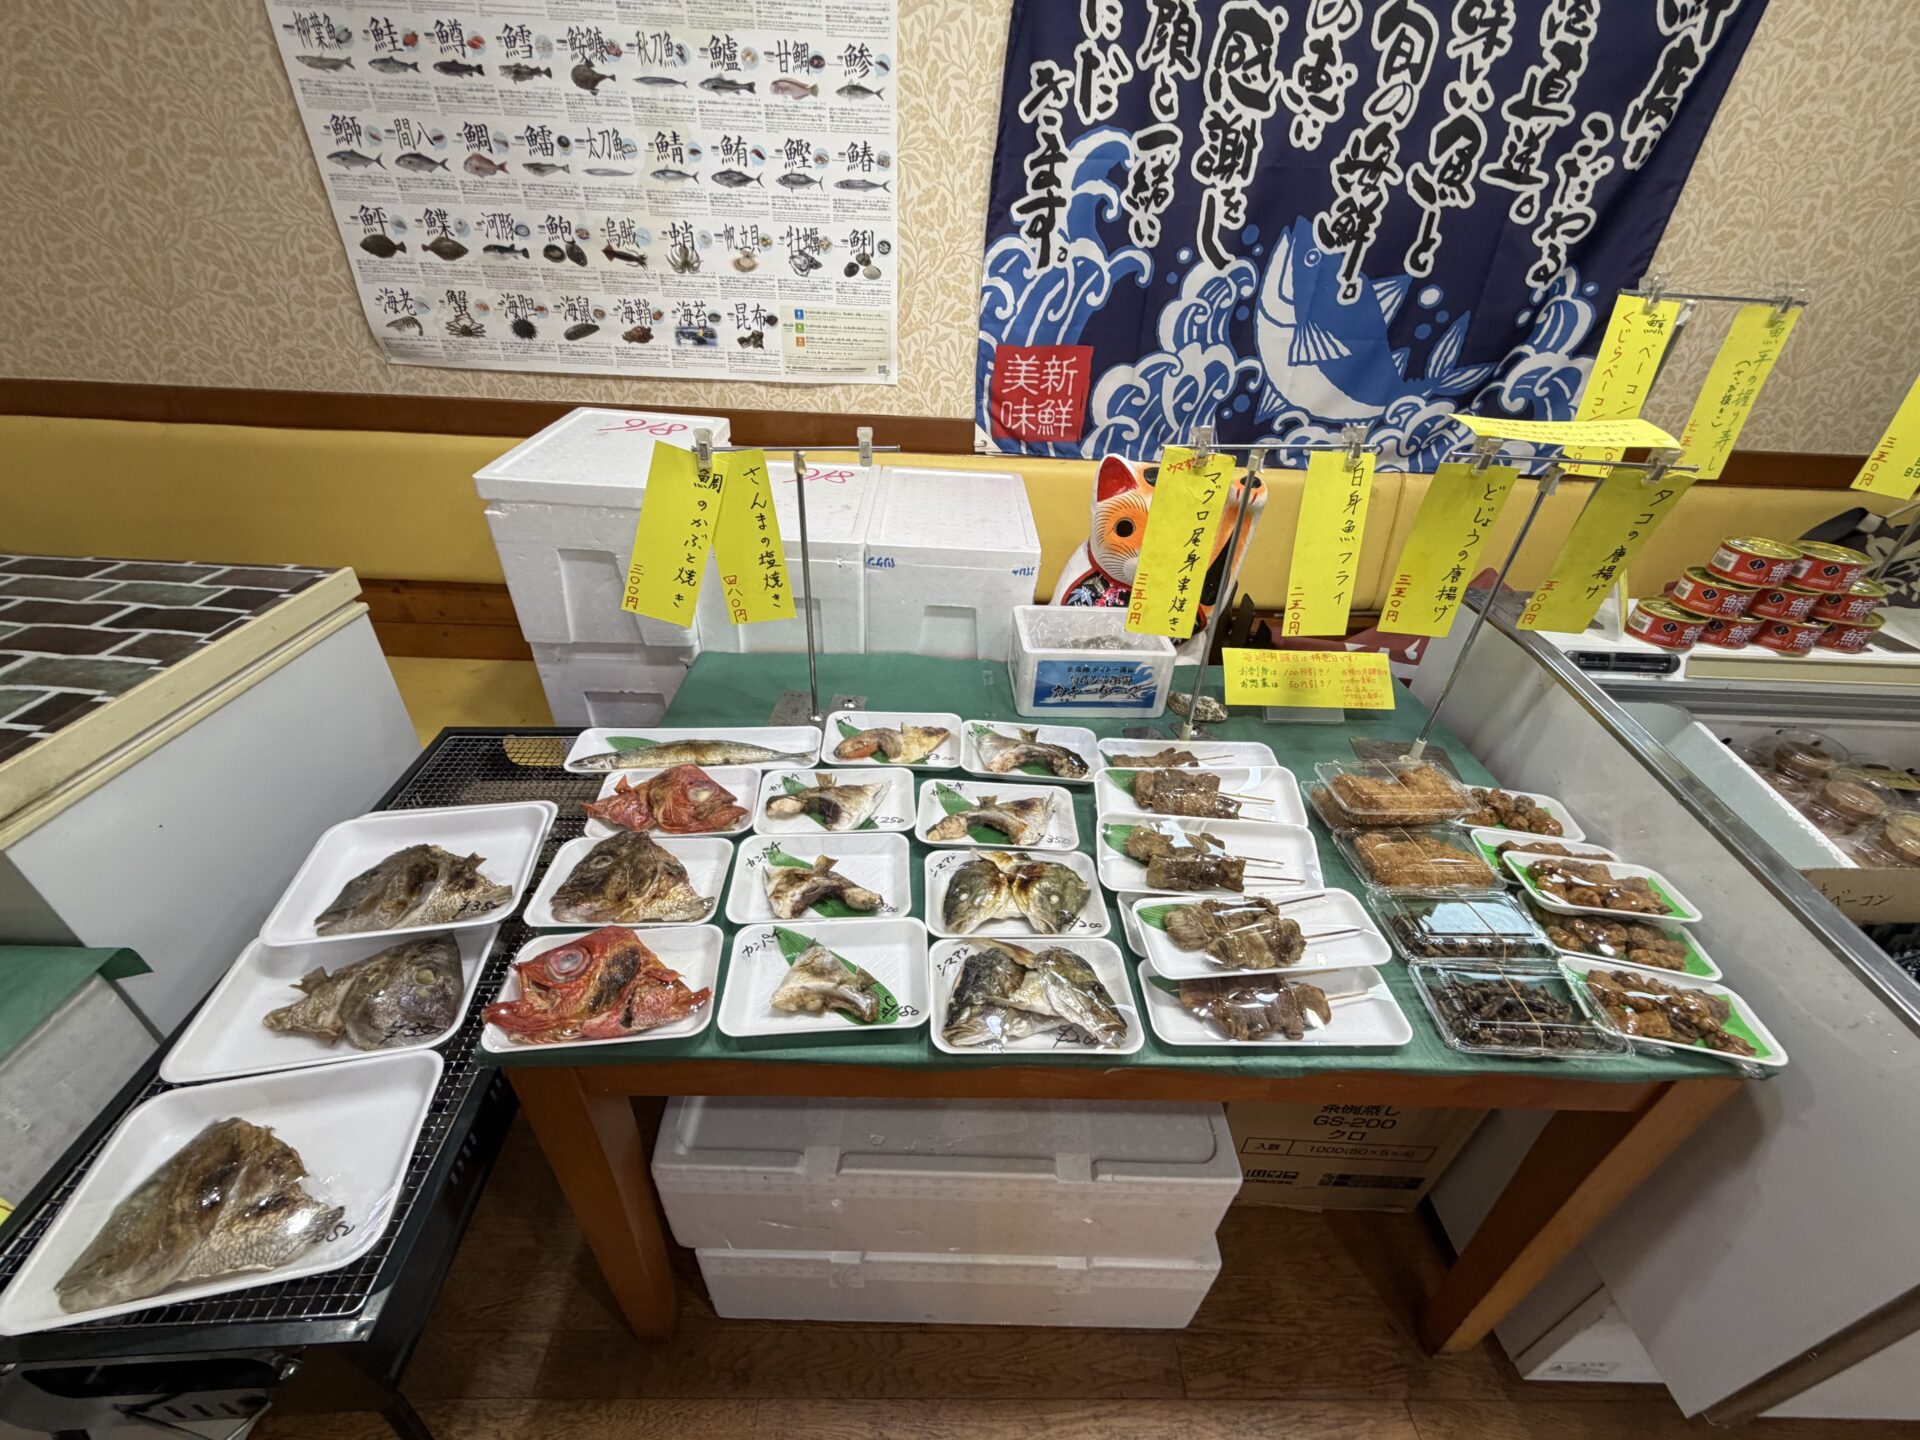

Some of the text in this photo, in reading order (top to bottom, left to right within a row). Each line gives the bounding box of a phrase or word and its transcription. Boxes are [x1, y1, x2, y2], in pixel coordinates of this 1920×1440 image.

[293, 10, 342, 50] 柳葉魚
[369, 17, 404, 53] 鮭
[434, 18, 467, 58] 鱒
[501, 23, 534, 59] 鱈
[634, 26, 677, 68] 秋刀魚
[707, 34, 743, 71] 鱸
[774, 39, 810, 75] 甘鯛
[330, 113, 362, 148] 鰤
[394, 118, 435, 151] 間八
[461, 121, 494, 155] 鯛
[585, 126, 627, 161] 太刀魚
[654, 130, 684, 166] 鯖
[720, 134, 748, 169] 鮪
[783, 137, 813, 171] 鰹
[846, 140, 875, 173] 鰆
[481, 211, 516, 243] 河豚
[545, 214, 576, 244] 鮑
[668, 220, 695, 251] 蛸
[723, 223, 762, 253] 帆立貝
[785, 225, 821, 256] 牡蠣
[376, 287, 417, 316] 海老
[445, 289, 471, 318] 蟹
[498, 292, 537, 320] 海胆
[560, 295, 597, 323] 海鼠
[675, 300, 708, 328] 海苔
[734, 302, 767, 331] 昆布
[1001, 353, 1040, 436] 美味
[1039, 354, 1079, 438] 新鮮
[672, 468, 724, 608] 鯛のかぶと焼き
[742, 466, 784, 608] さんまの塩焼き
[1333, 461, 1363, 605] 白身魚フライ
[1586, 489, 1674, 600] タコの唐揚げ
[1433, 482, 1506, 623] どじょうの唐揚げ
[742, 928, 782, 957] カンパチ
[1313, 1115, 1397, 1130] GS-200
[1328, 1130, 1367, 1142] クロ
